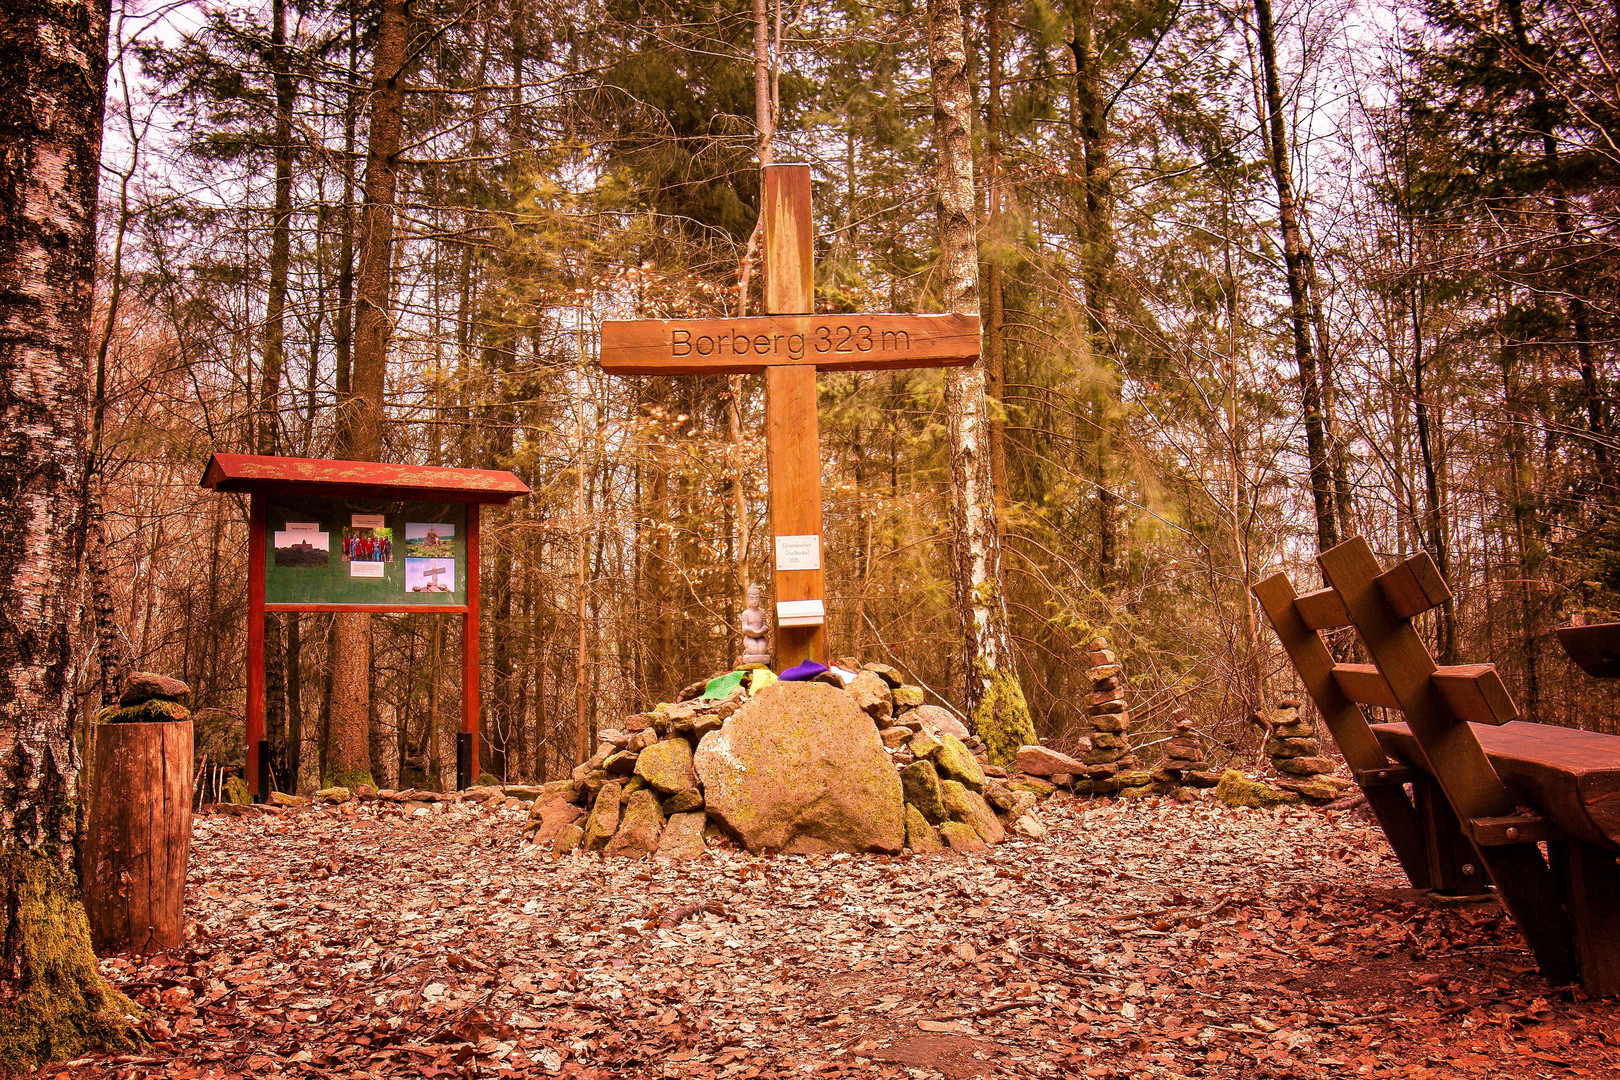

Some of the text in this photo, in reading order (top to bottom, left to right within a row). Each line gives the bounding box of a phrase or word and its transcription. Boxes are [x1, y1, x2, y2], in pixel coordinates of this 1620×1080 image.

[671, 325, 910, 361] Borberg 323 m
